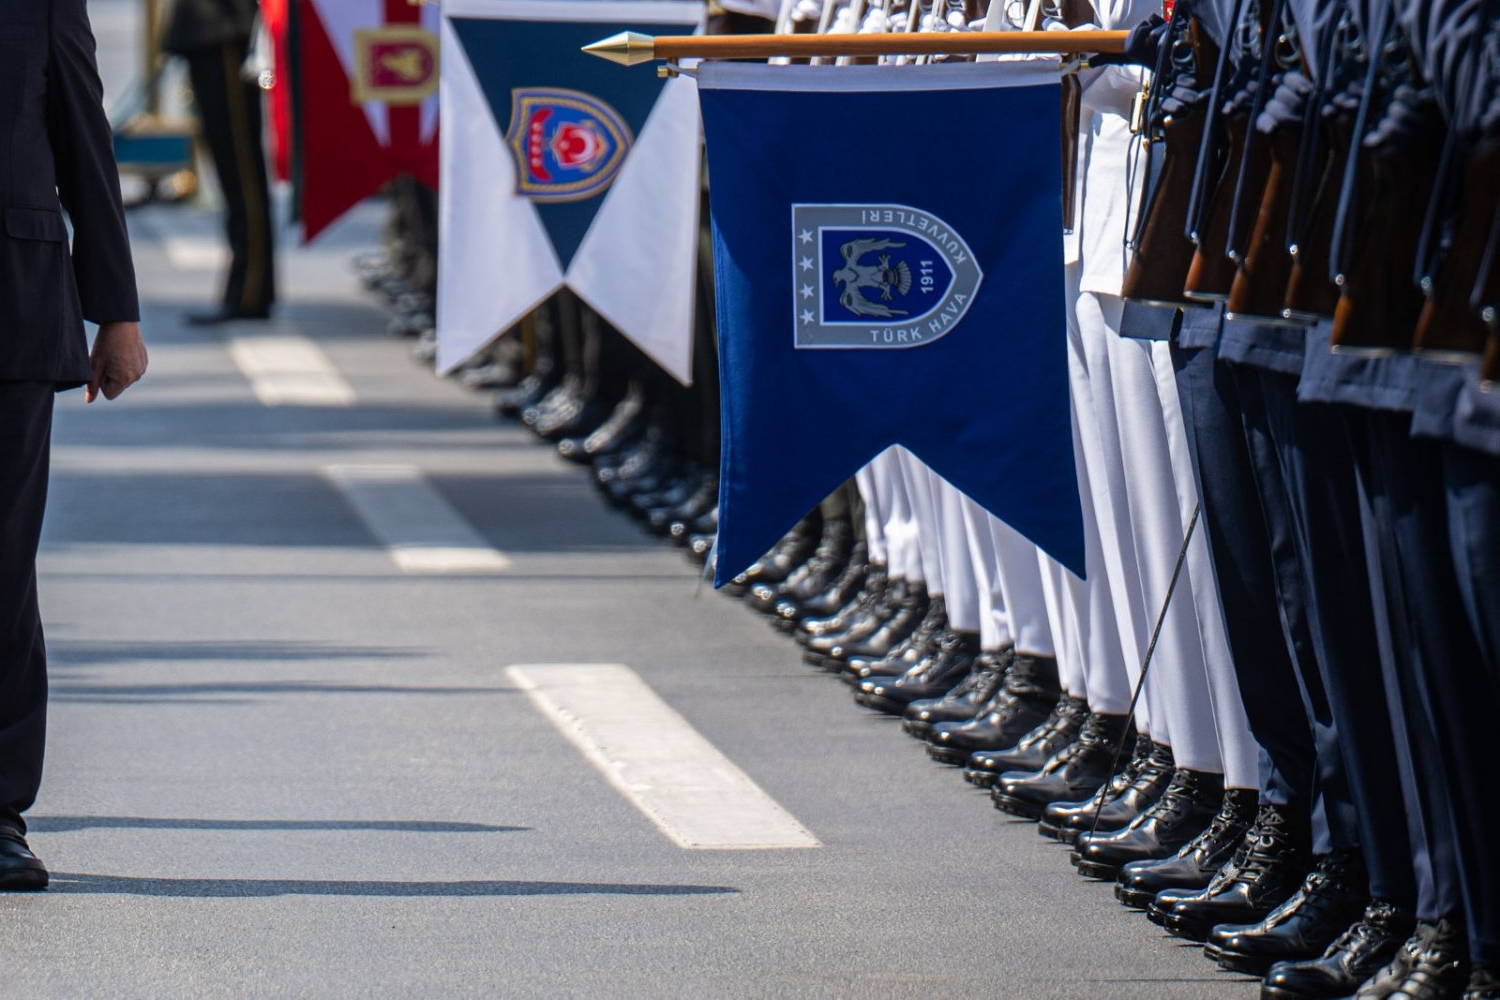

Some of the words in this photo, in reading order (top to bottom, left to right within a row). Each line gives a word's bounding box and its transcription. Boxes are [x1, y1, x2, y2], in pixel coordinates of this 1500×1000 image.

[862, 210, 966, 264] KUVVETLERİ
[920, 260, 934, 294] 1911
[928, 292, 967, 333] HAVA
[870, 328, 922, 343] TÜRK
